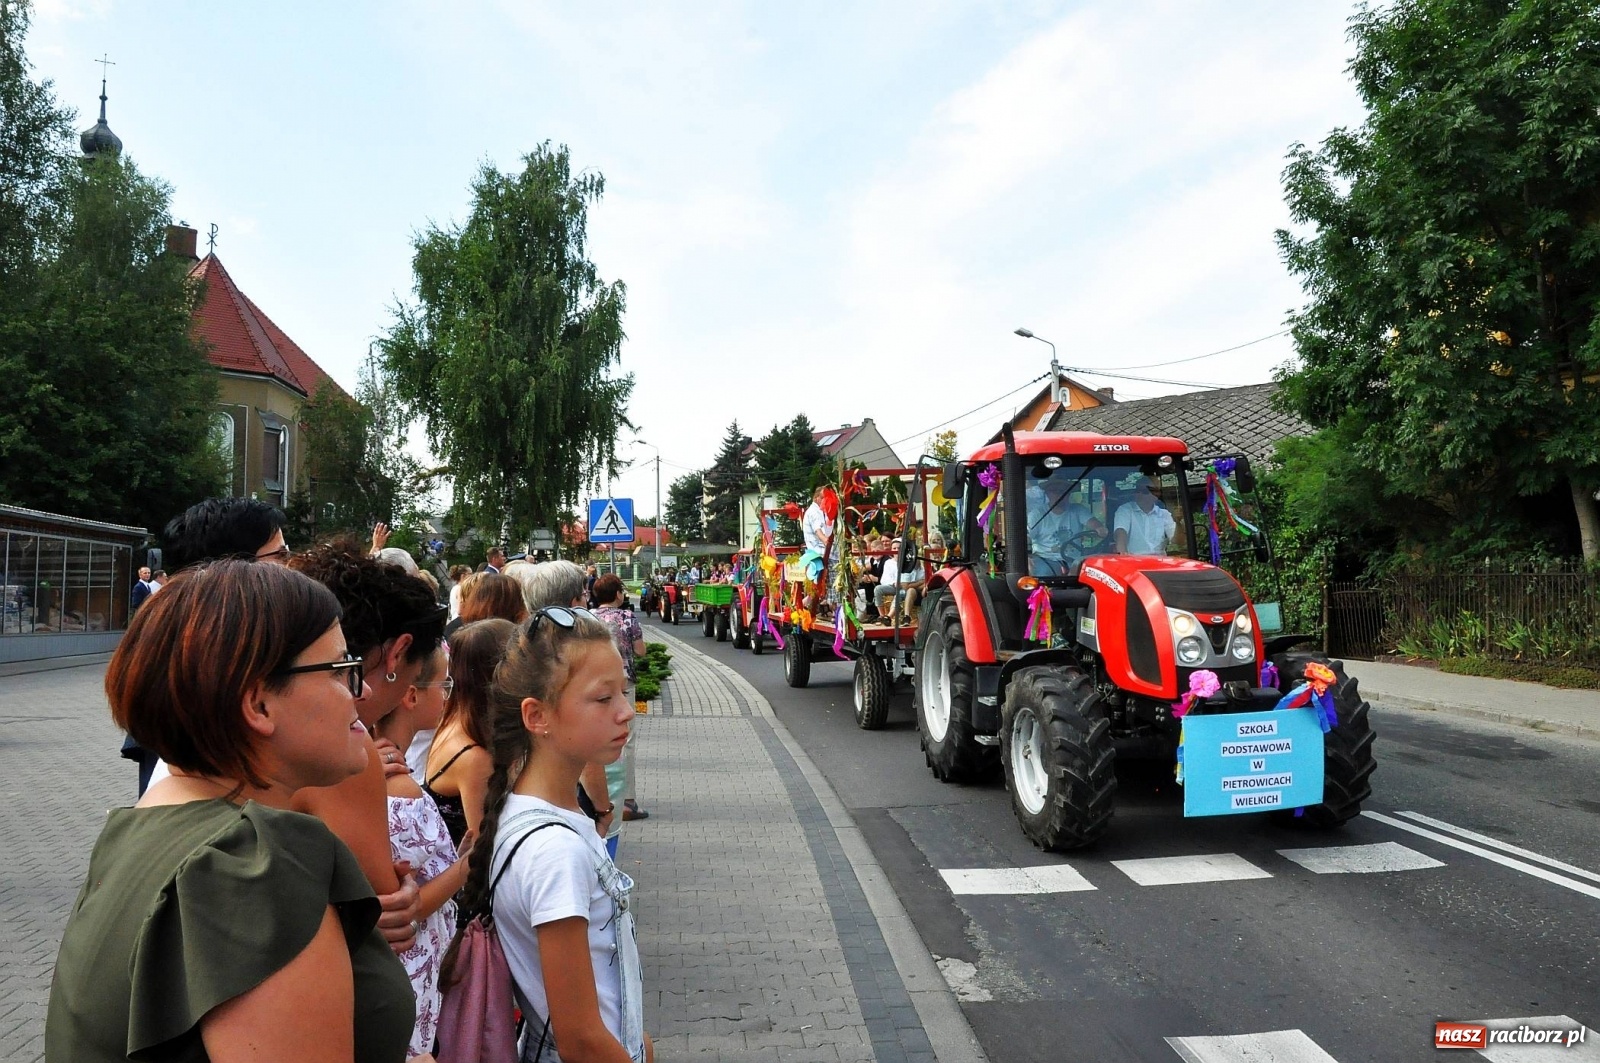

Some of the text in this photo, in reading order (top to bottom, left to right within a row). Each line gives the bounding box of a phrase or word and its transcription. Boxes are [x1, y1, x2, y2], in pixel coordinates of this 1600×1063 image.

[1093, 444, 1130, 452] ZETOR
[1239, 724, 1274, 735] SZKOŁA
[1222, 742, 1291, 755] PODSTAWOWA
[1253, 760, 1263, 769] W
[1223, 776, 1292, 789] PIETROWICACH
[1235, 794, 1279, 807] WIELKICH
